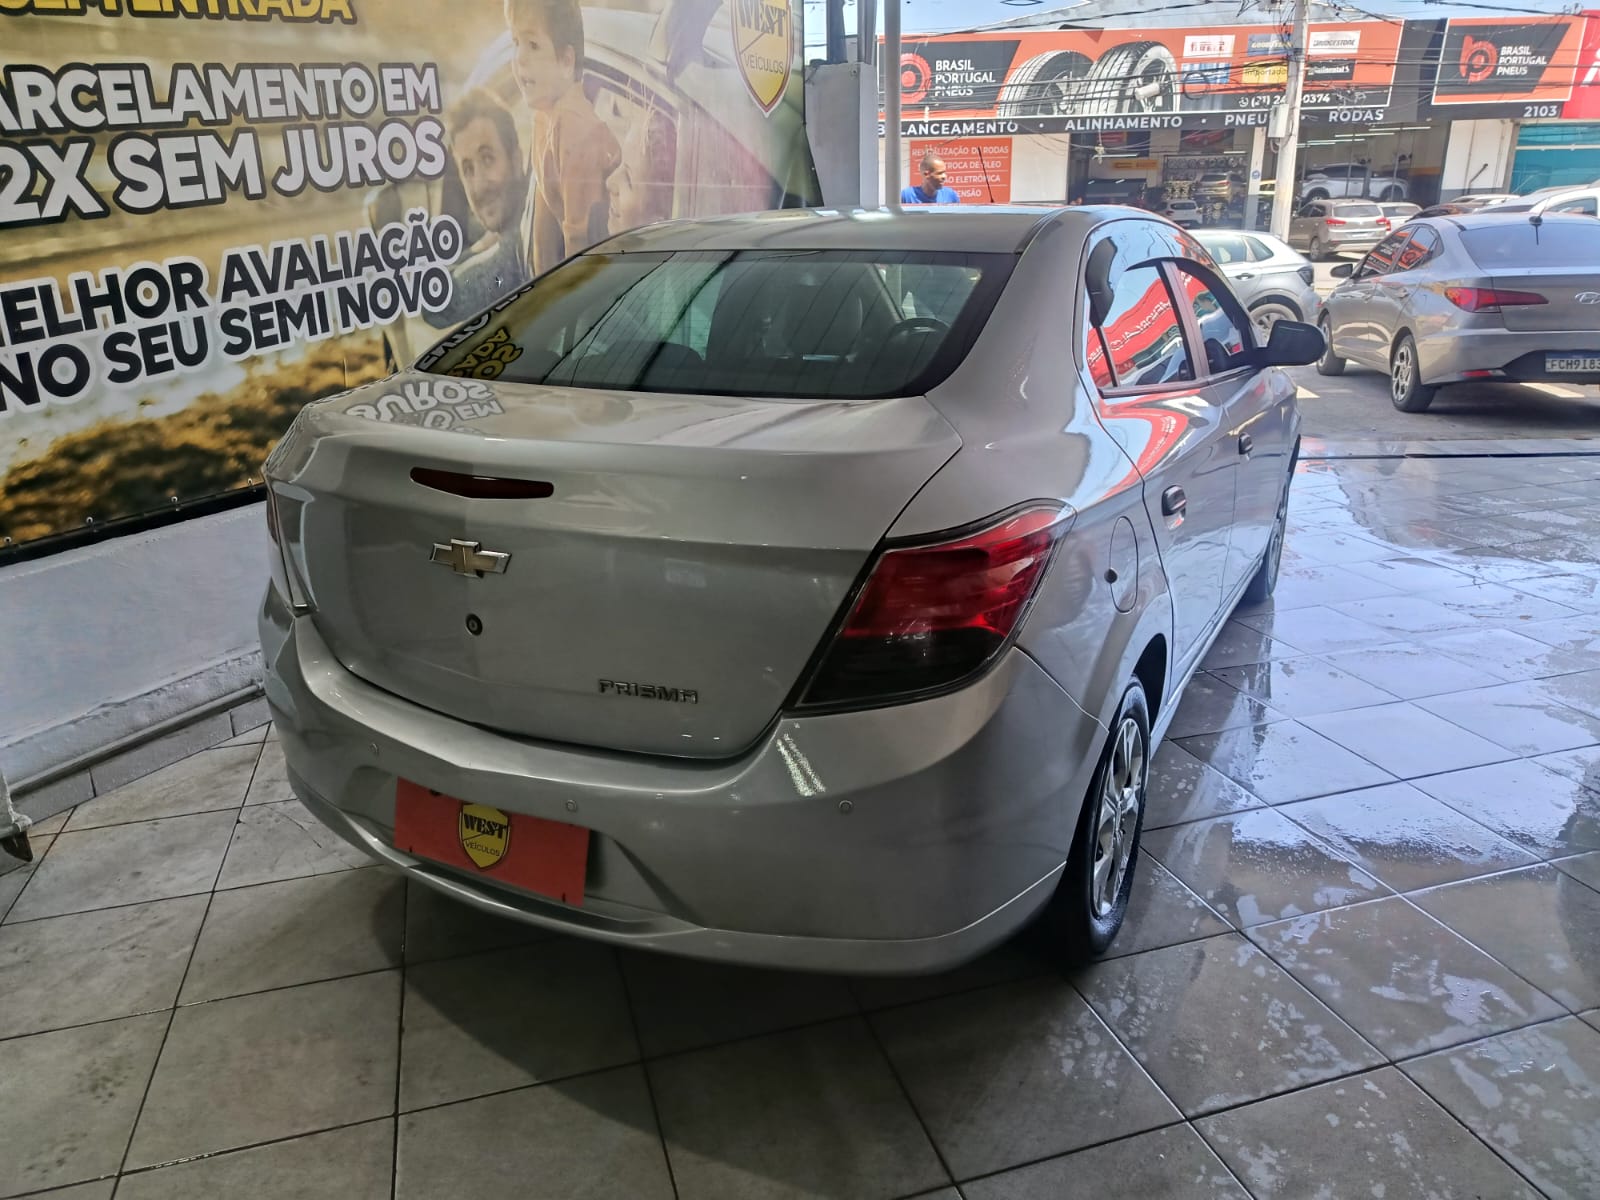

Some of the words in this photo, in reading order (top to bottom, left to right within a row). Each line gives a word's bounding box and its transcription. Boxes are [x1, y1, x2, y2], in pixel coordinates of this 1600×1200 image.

[1500, 46, 1532, 56] BRASIL
[935, 59, 975, 71] BRASIL
[1498, 56, 1547, 65] PORTUGAL
[935, 72, 996, 84] PORTUGAL
[1496, 66, 1528, 76] PNEUS
[381, 67, 439, 112] EM
[1065, 116, 1183, 131] ALINHAMENTO
[1225, 113, 1269, 127] PNEU
[1328, 109, 1384, 122] RODAS
[1523, 105, 1558, 118] 2103
[983, 146, 1009, 154] RODAS
[113, 131, 262, 208] SEM
[276, 120, 446, 192] JUROS
[0, 262, 209, 347] ELHOR
[221, 212, 460, 303] AVALIAÇÃO
[103, 316, 208, 384] SEU
[220, 291, 330, 356] SEMI
[337, 266, 450, 329] NOVO
[599, 679, 698, 704] PRISMA
[463, 813, 507, 839] WEST
